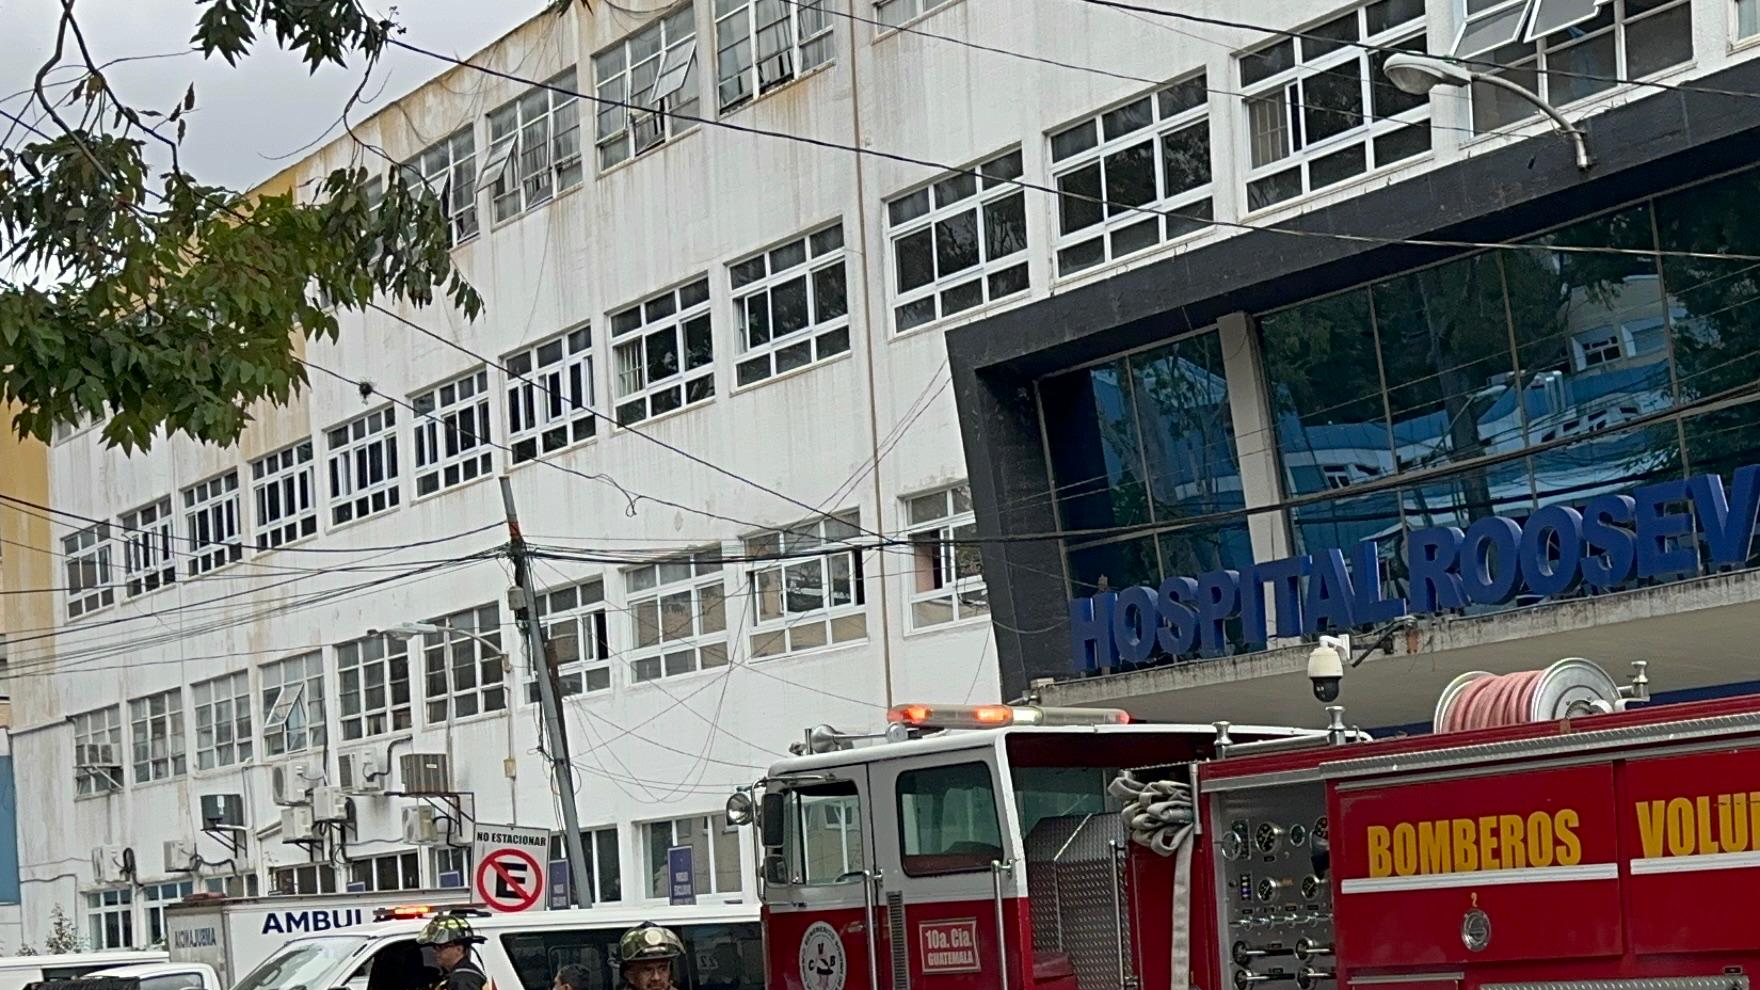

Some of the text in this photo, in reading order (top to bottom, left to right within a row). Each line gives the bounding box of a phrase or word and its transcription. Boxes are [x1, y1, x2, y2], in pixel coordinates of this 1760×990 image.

[1071, 541, 1406, 672] HOSPITAL
[477, 832, 546, 847] NO ESTACIONAR
[1367, 809, 1582, 878] BOMBEROS
[1470, 892, 1478, 908] 2
[925, 927, 973, 950] 10a. Cia.
[927, 950, 974, 966] GUATEMALA
